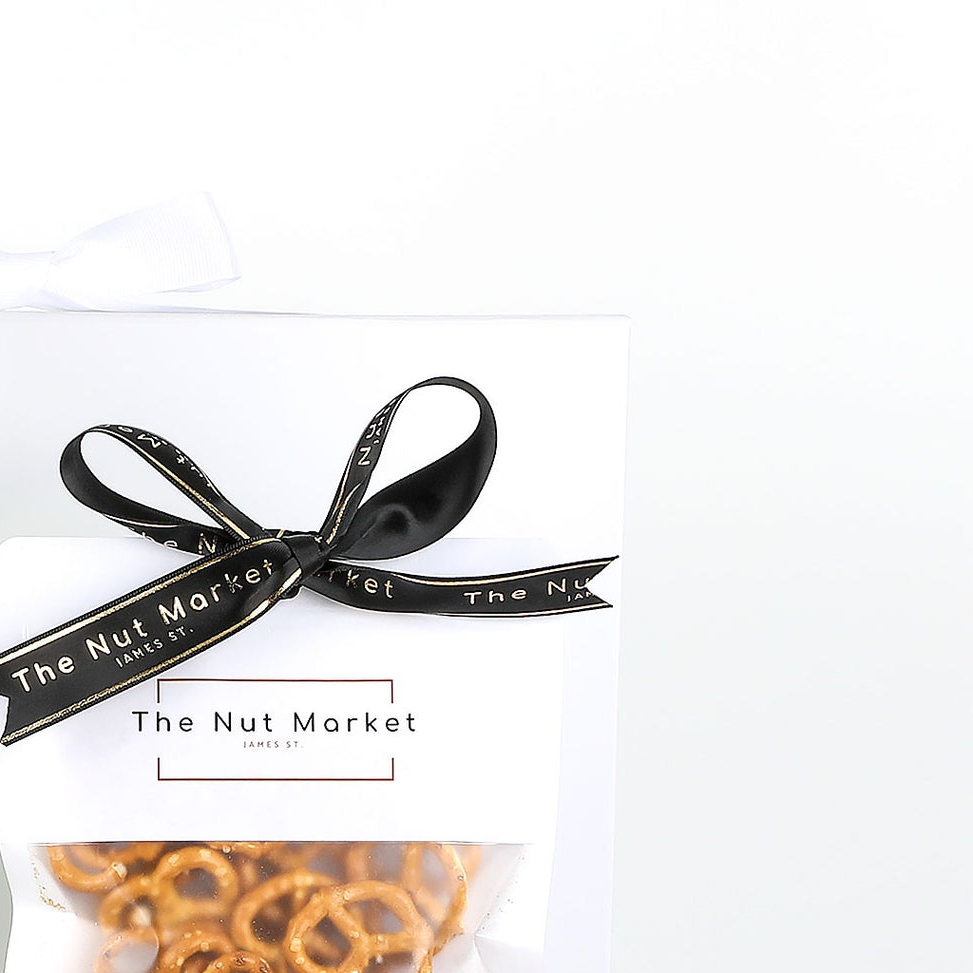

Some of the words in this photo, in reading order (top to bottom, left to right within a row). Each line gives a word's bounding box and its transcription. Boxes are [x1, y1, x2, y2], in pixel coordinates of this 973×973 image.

[464, 588, 527, 605] The
[548, 578, 591, 596] Nu
[11, 655, 76, 693] The
[84, 618, 149, 661] Nut
[157, 558, 274, 626] Market
[115, 638, 164, 668] JAMES
[168, 625, 194, 642] ST.
[132, 711, 194, 732] The
[215, 711, 273, 733] Nut
[293, 711, 416, 733] Market
[243, 740, 280, 748] JAMES
[286, 740, 304, 748] ST.
